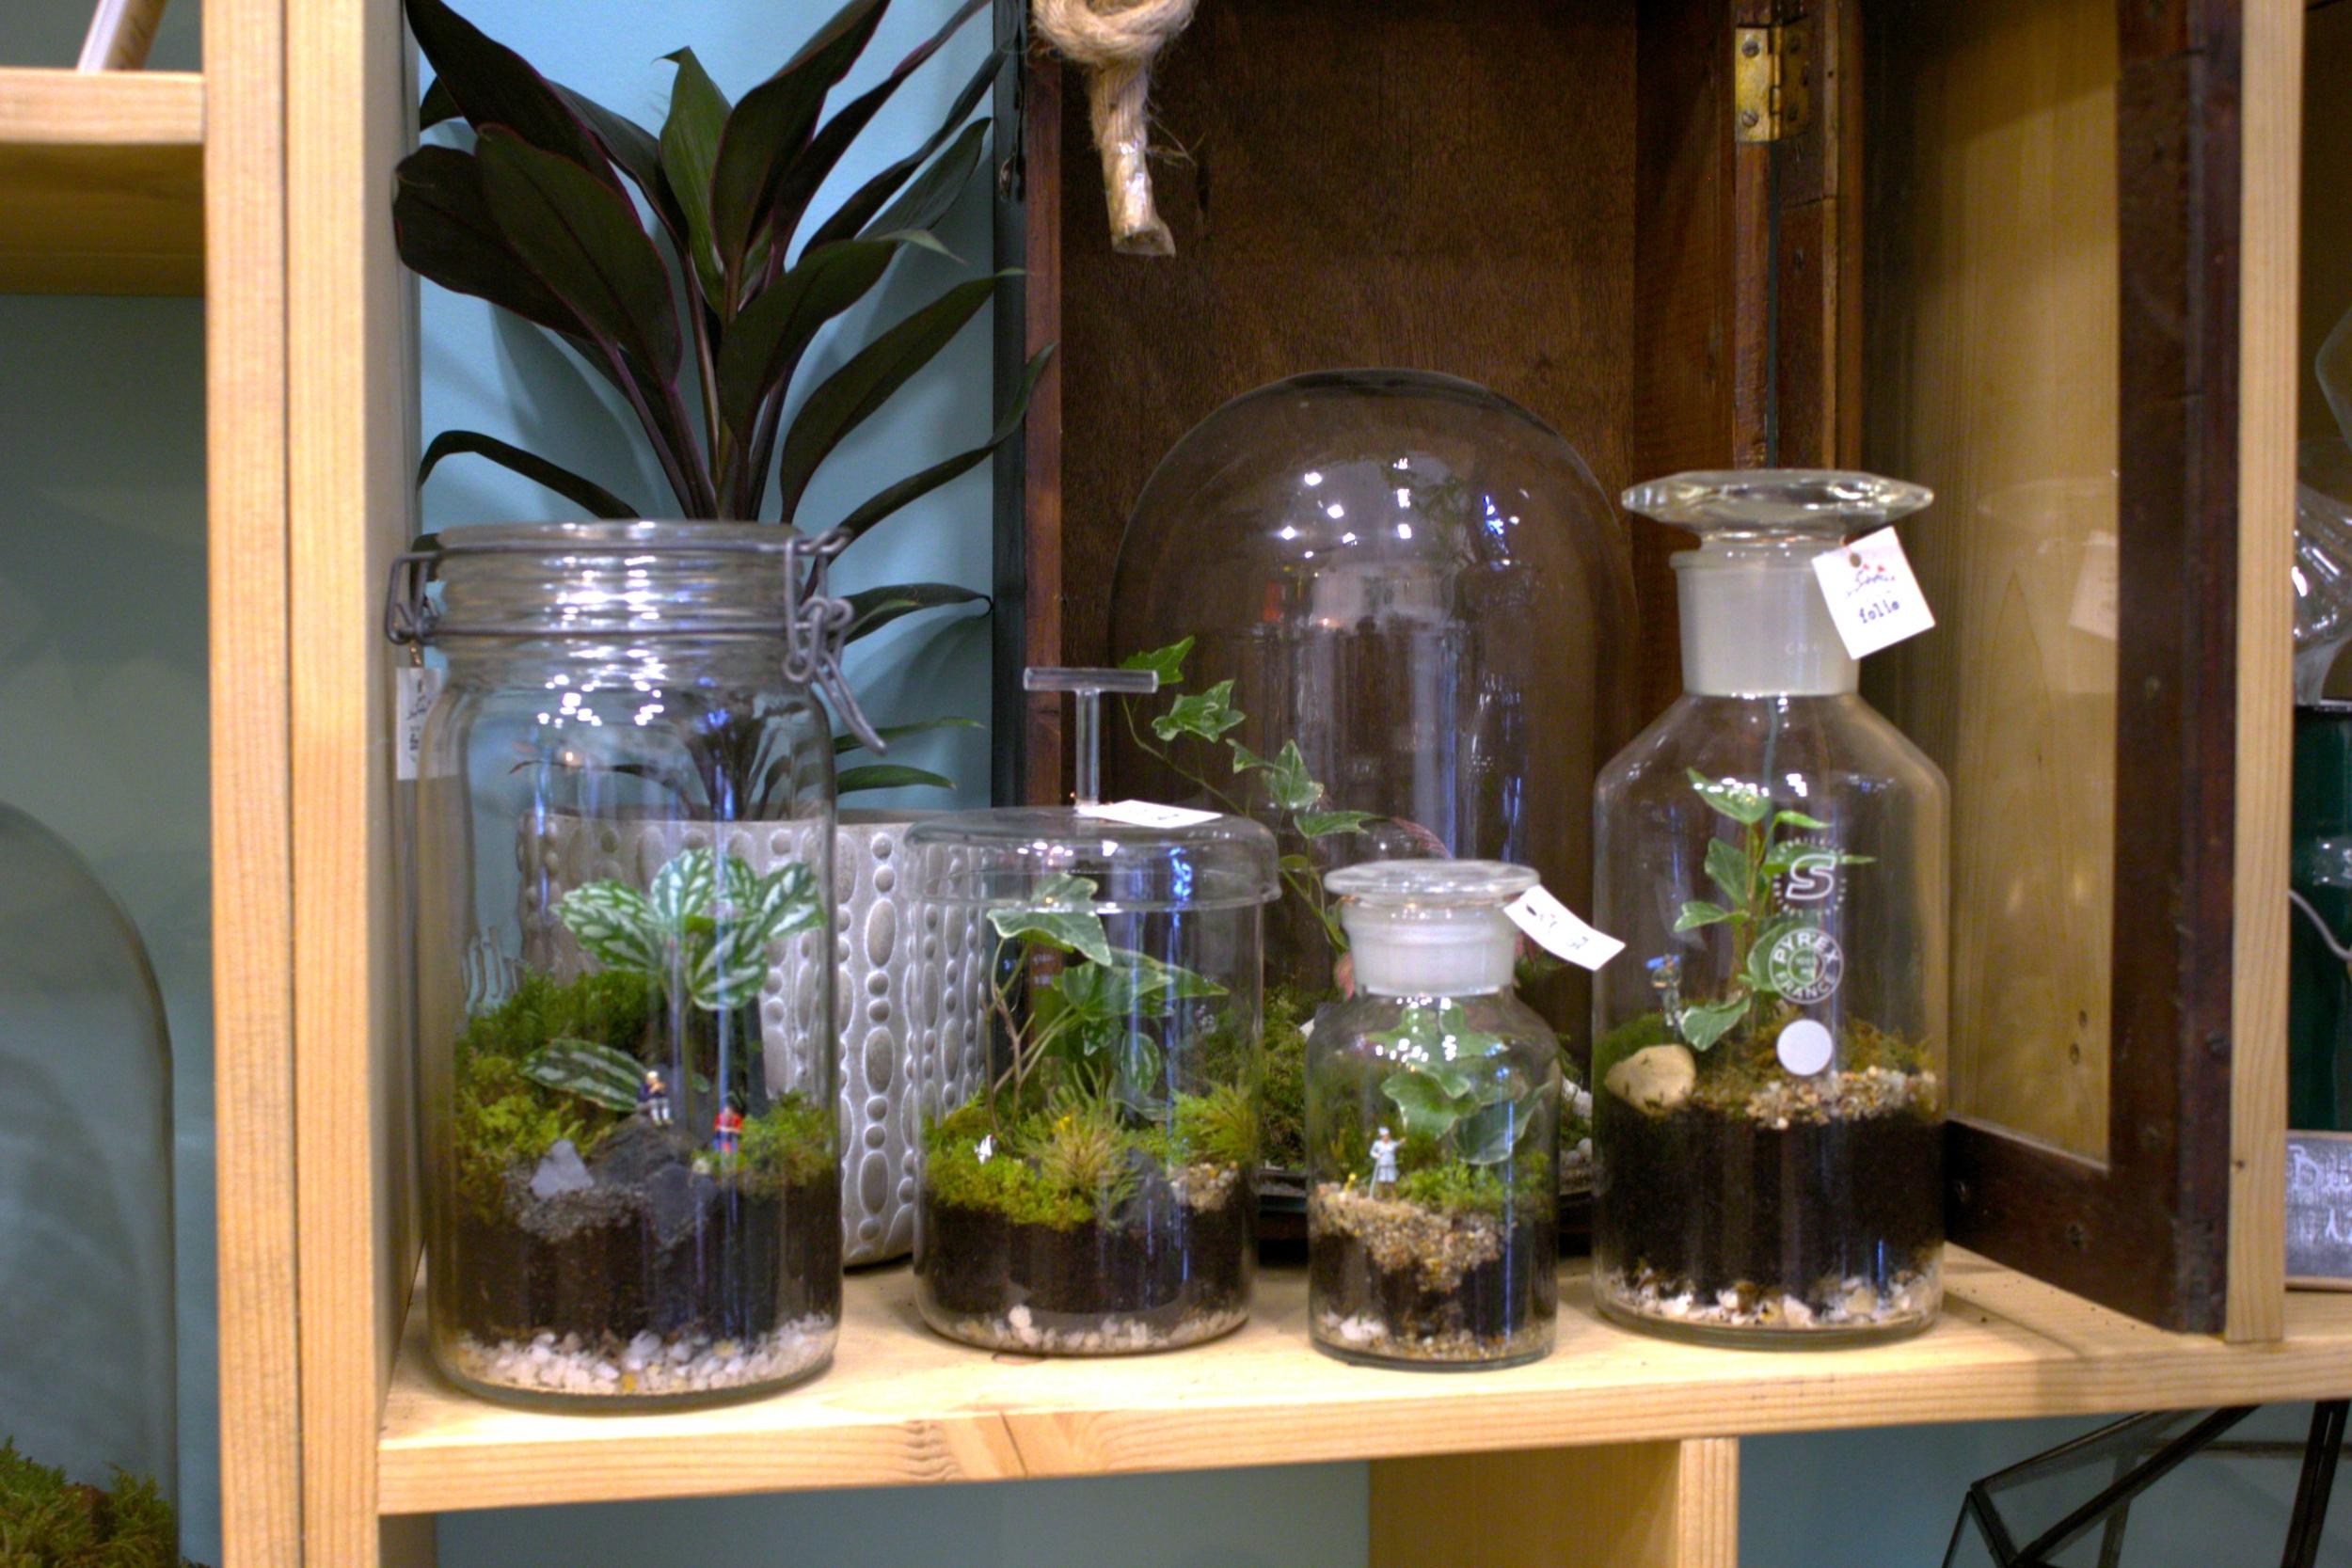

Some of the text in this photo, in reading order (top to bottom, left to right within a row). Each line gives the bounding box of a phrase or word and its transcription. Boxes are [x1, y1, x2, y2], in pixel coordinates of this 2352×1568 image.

[1785, 854, 1836, 901] S
[1772, 932, 1839, 964] PYREX
[1775, 972, 1837, 999] FRANCE
